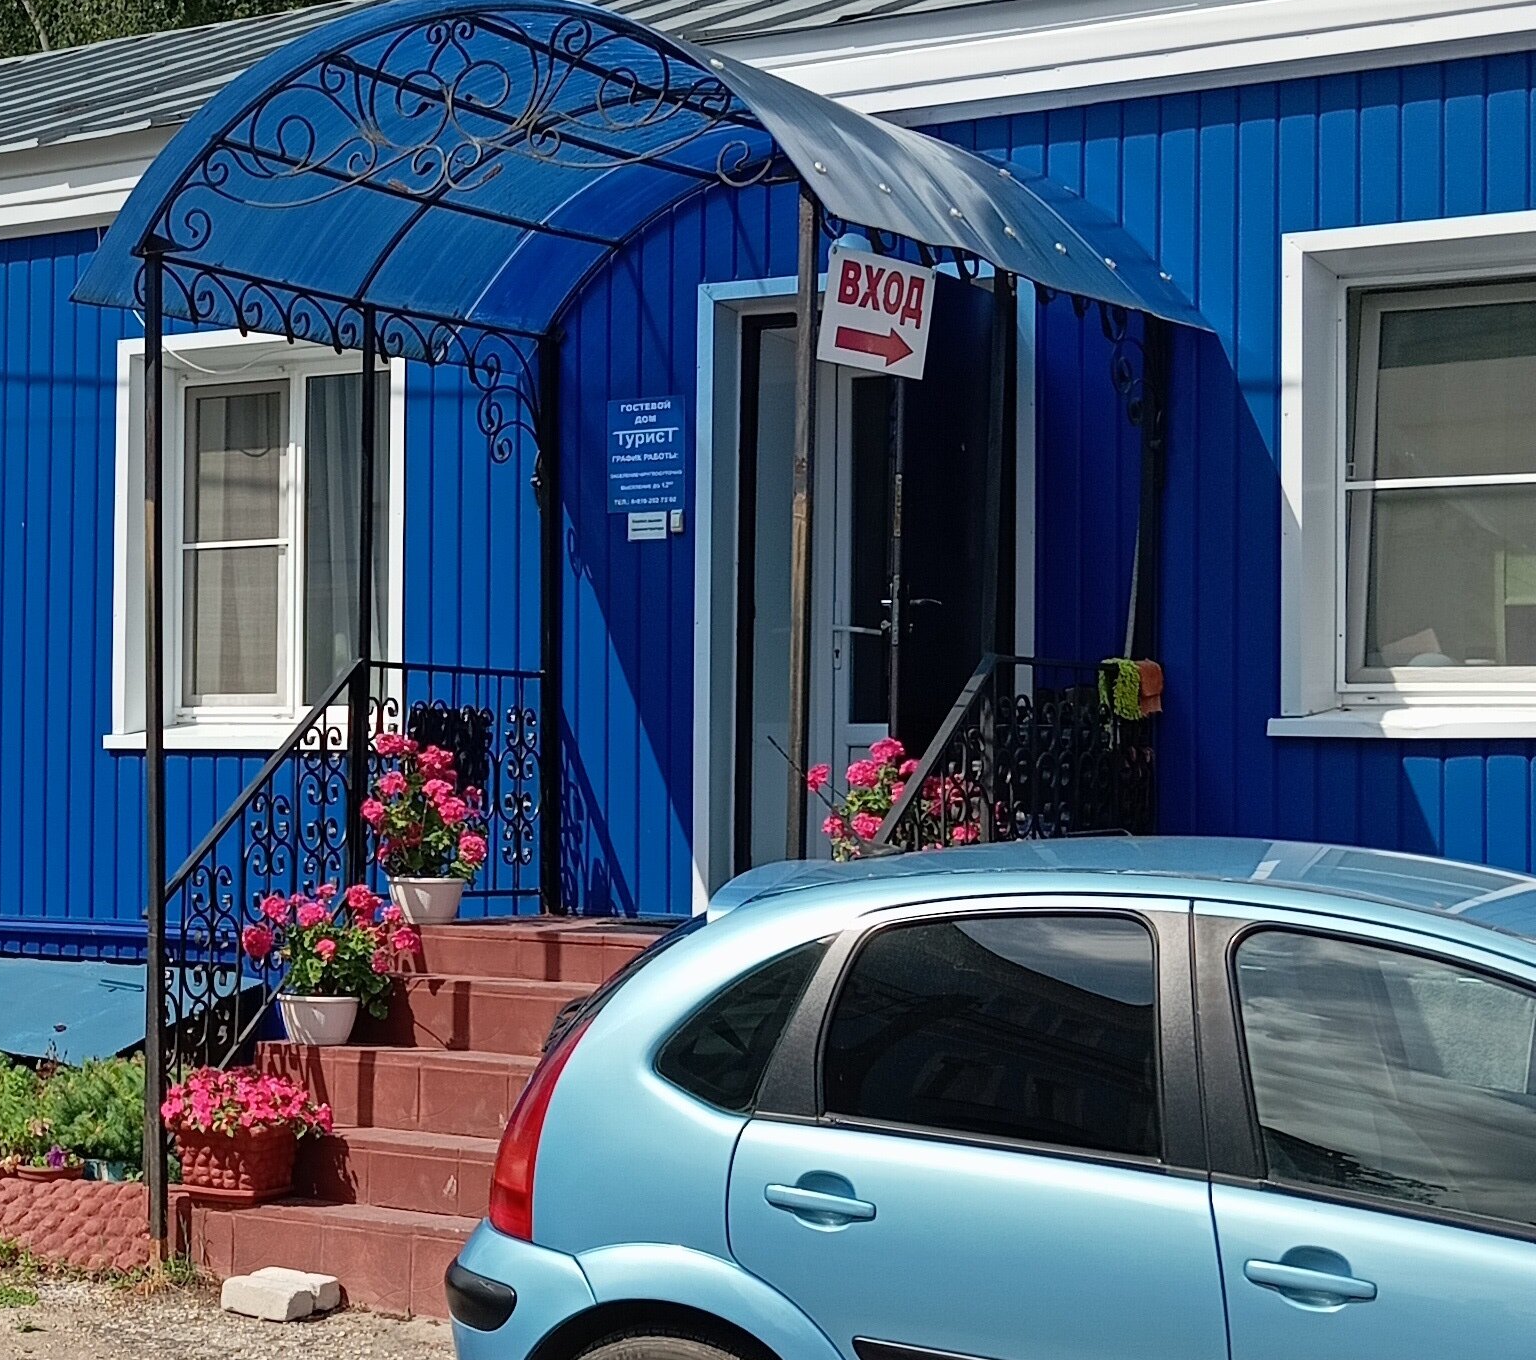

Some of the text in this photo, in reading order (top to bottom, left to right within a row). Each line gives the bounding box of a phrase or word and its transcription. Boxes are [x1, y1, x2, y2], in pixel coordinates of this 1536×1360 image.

[838, 259, 925, 329] ВХОД
[620, 400, 671, 412] ГОСТЕВОЙ
[634, 415, 657, 425] ДОМ
